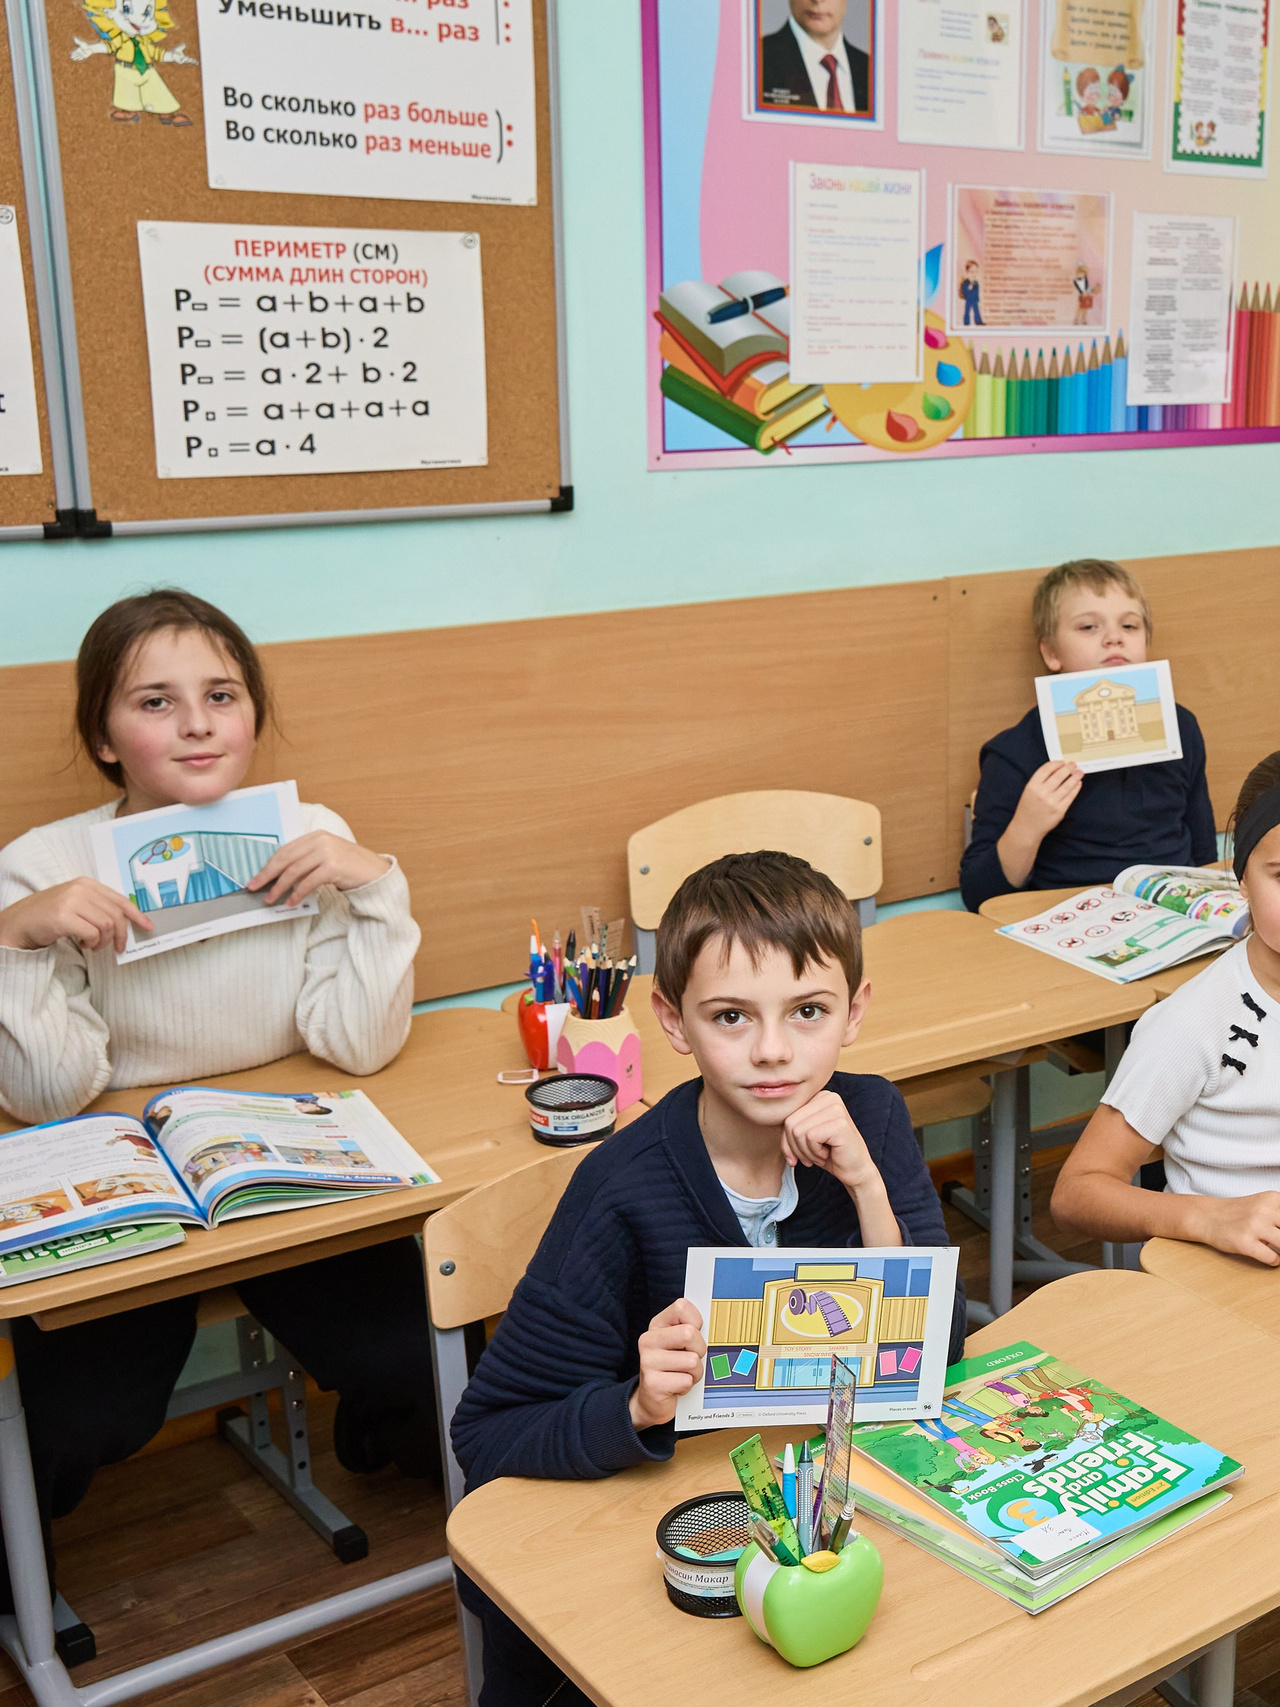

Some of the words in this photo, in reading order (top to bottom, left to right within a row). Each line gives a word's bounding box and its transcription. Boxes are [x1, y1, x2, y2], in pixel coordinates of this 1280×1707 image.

[218, 0, 382, 31] Уменьшить
[437, 21, 480, 43] раз
[223, 86, 253, 108] Во
[261, 92, 356, 117] сколько
[364, 101, 401, 123] раз
[407, 101, 490, 128] больше
[225, 120, 254, 142] Во
[263, 125, 357, 149] сколько
[365, 133, 402, 155] раз
[409, 138, 492, 158] меньше
[234, 239, 347, 259] ПЕРИМЕТР
[353, 243, 400, 264] (СМ)
[203, 265, 284, 286] (СУММА
[290, 266, 344, 286] ДЛИН
[349, 268, 428, 288] СТОРОН)
[571, 1108, 606, 1120] ORGANIZER
[986, 1351, 1024, 1368] OXFORD
[1021, 1431, 1158, 1498] Friends
[966, 1481, 997, 1502] Book
[995, 1473, 1026, 1491] Class
[1058, 1450, 1189, 1517] Family
[1065, 1470, 1103, 1495] and
[1130, 1487, 1156, 1504] Edition
[1006, 1499, 1050, 1528] 3
[694, 1574, 729, 1584] Макар
